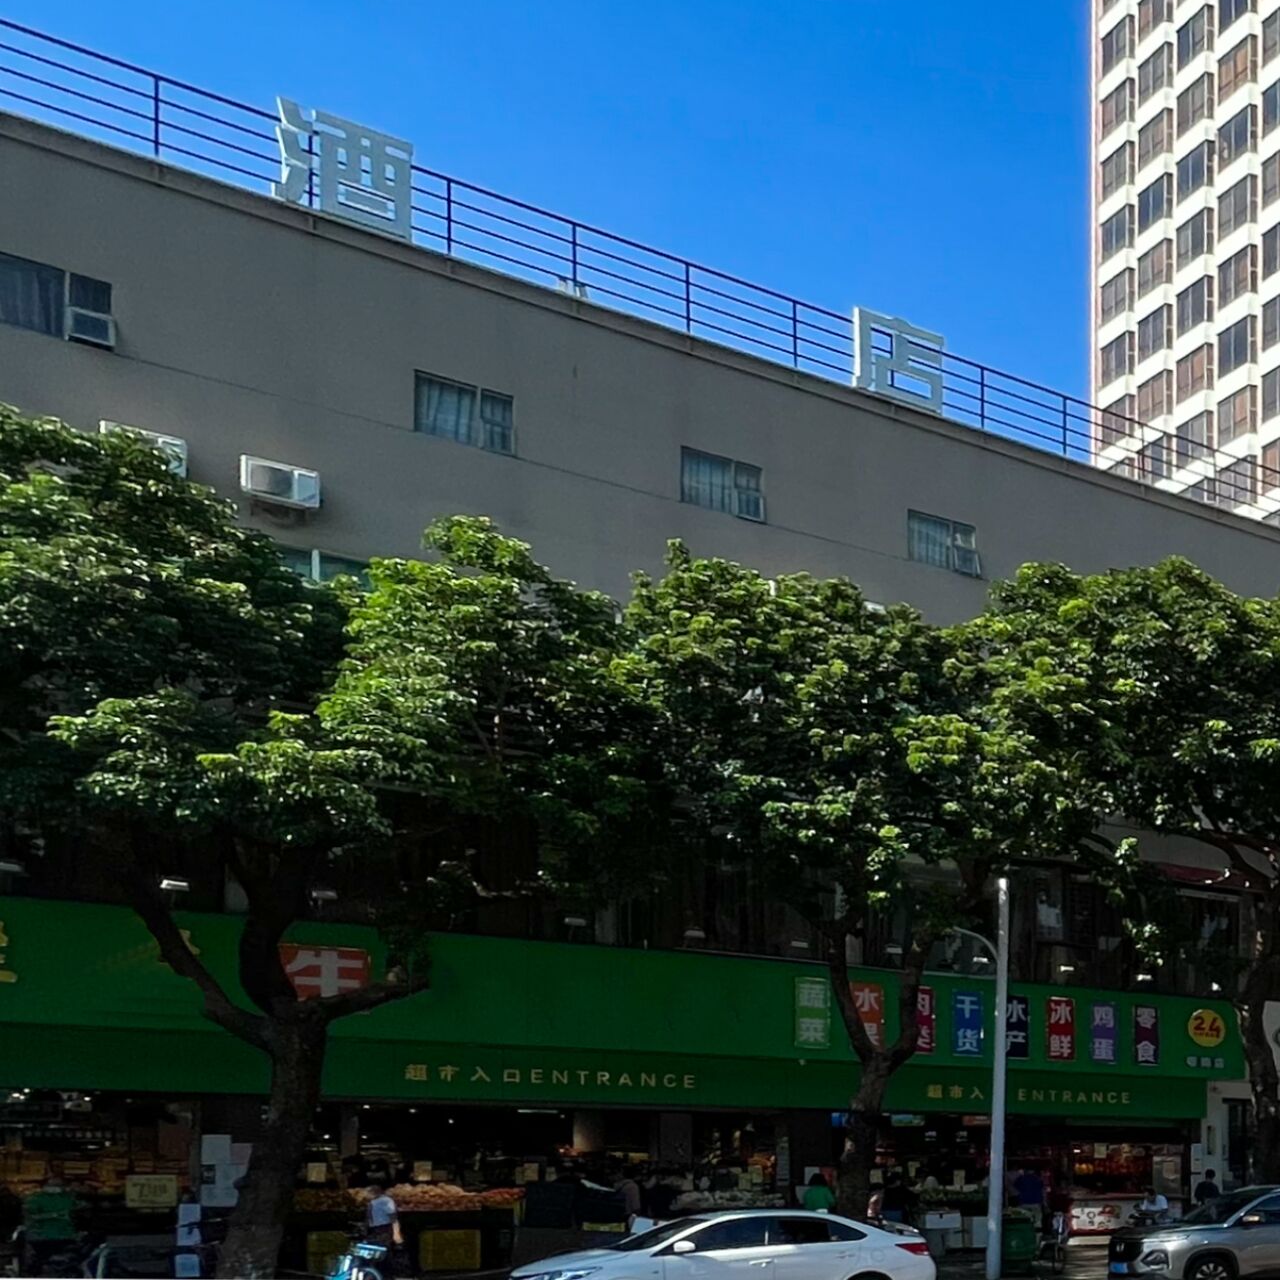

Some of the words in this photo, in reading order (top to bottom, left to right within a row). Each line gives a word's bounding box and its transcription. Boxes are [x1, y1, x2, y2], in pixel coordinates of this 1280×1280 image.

[799, 983, 826, 1043] 蔬菜
[955, 995, 980, 1053] 干货
[1006, 1000, 1027, 1053] 水产
[1049, 1001, 1072, 1059] 冰鲜
[1092, 1006, 1115, 1061] 鸡蛋
[1136, 1007, 1157, 1063] 零食
[1193, 1016, 1221, 1038] 24
[926, 1083, 985, 1100] 超市入
[1017, 1087, 1133, 1105] ENTRANCE
